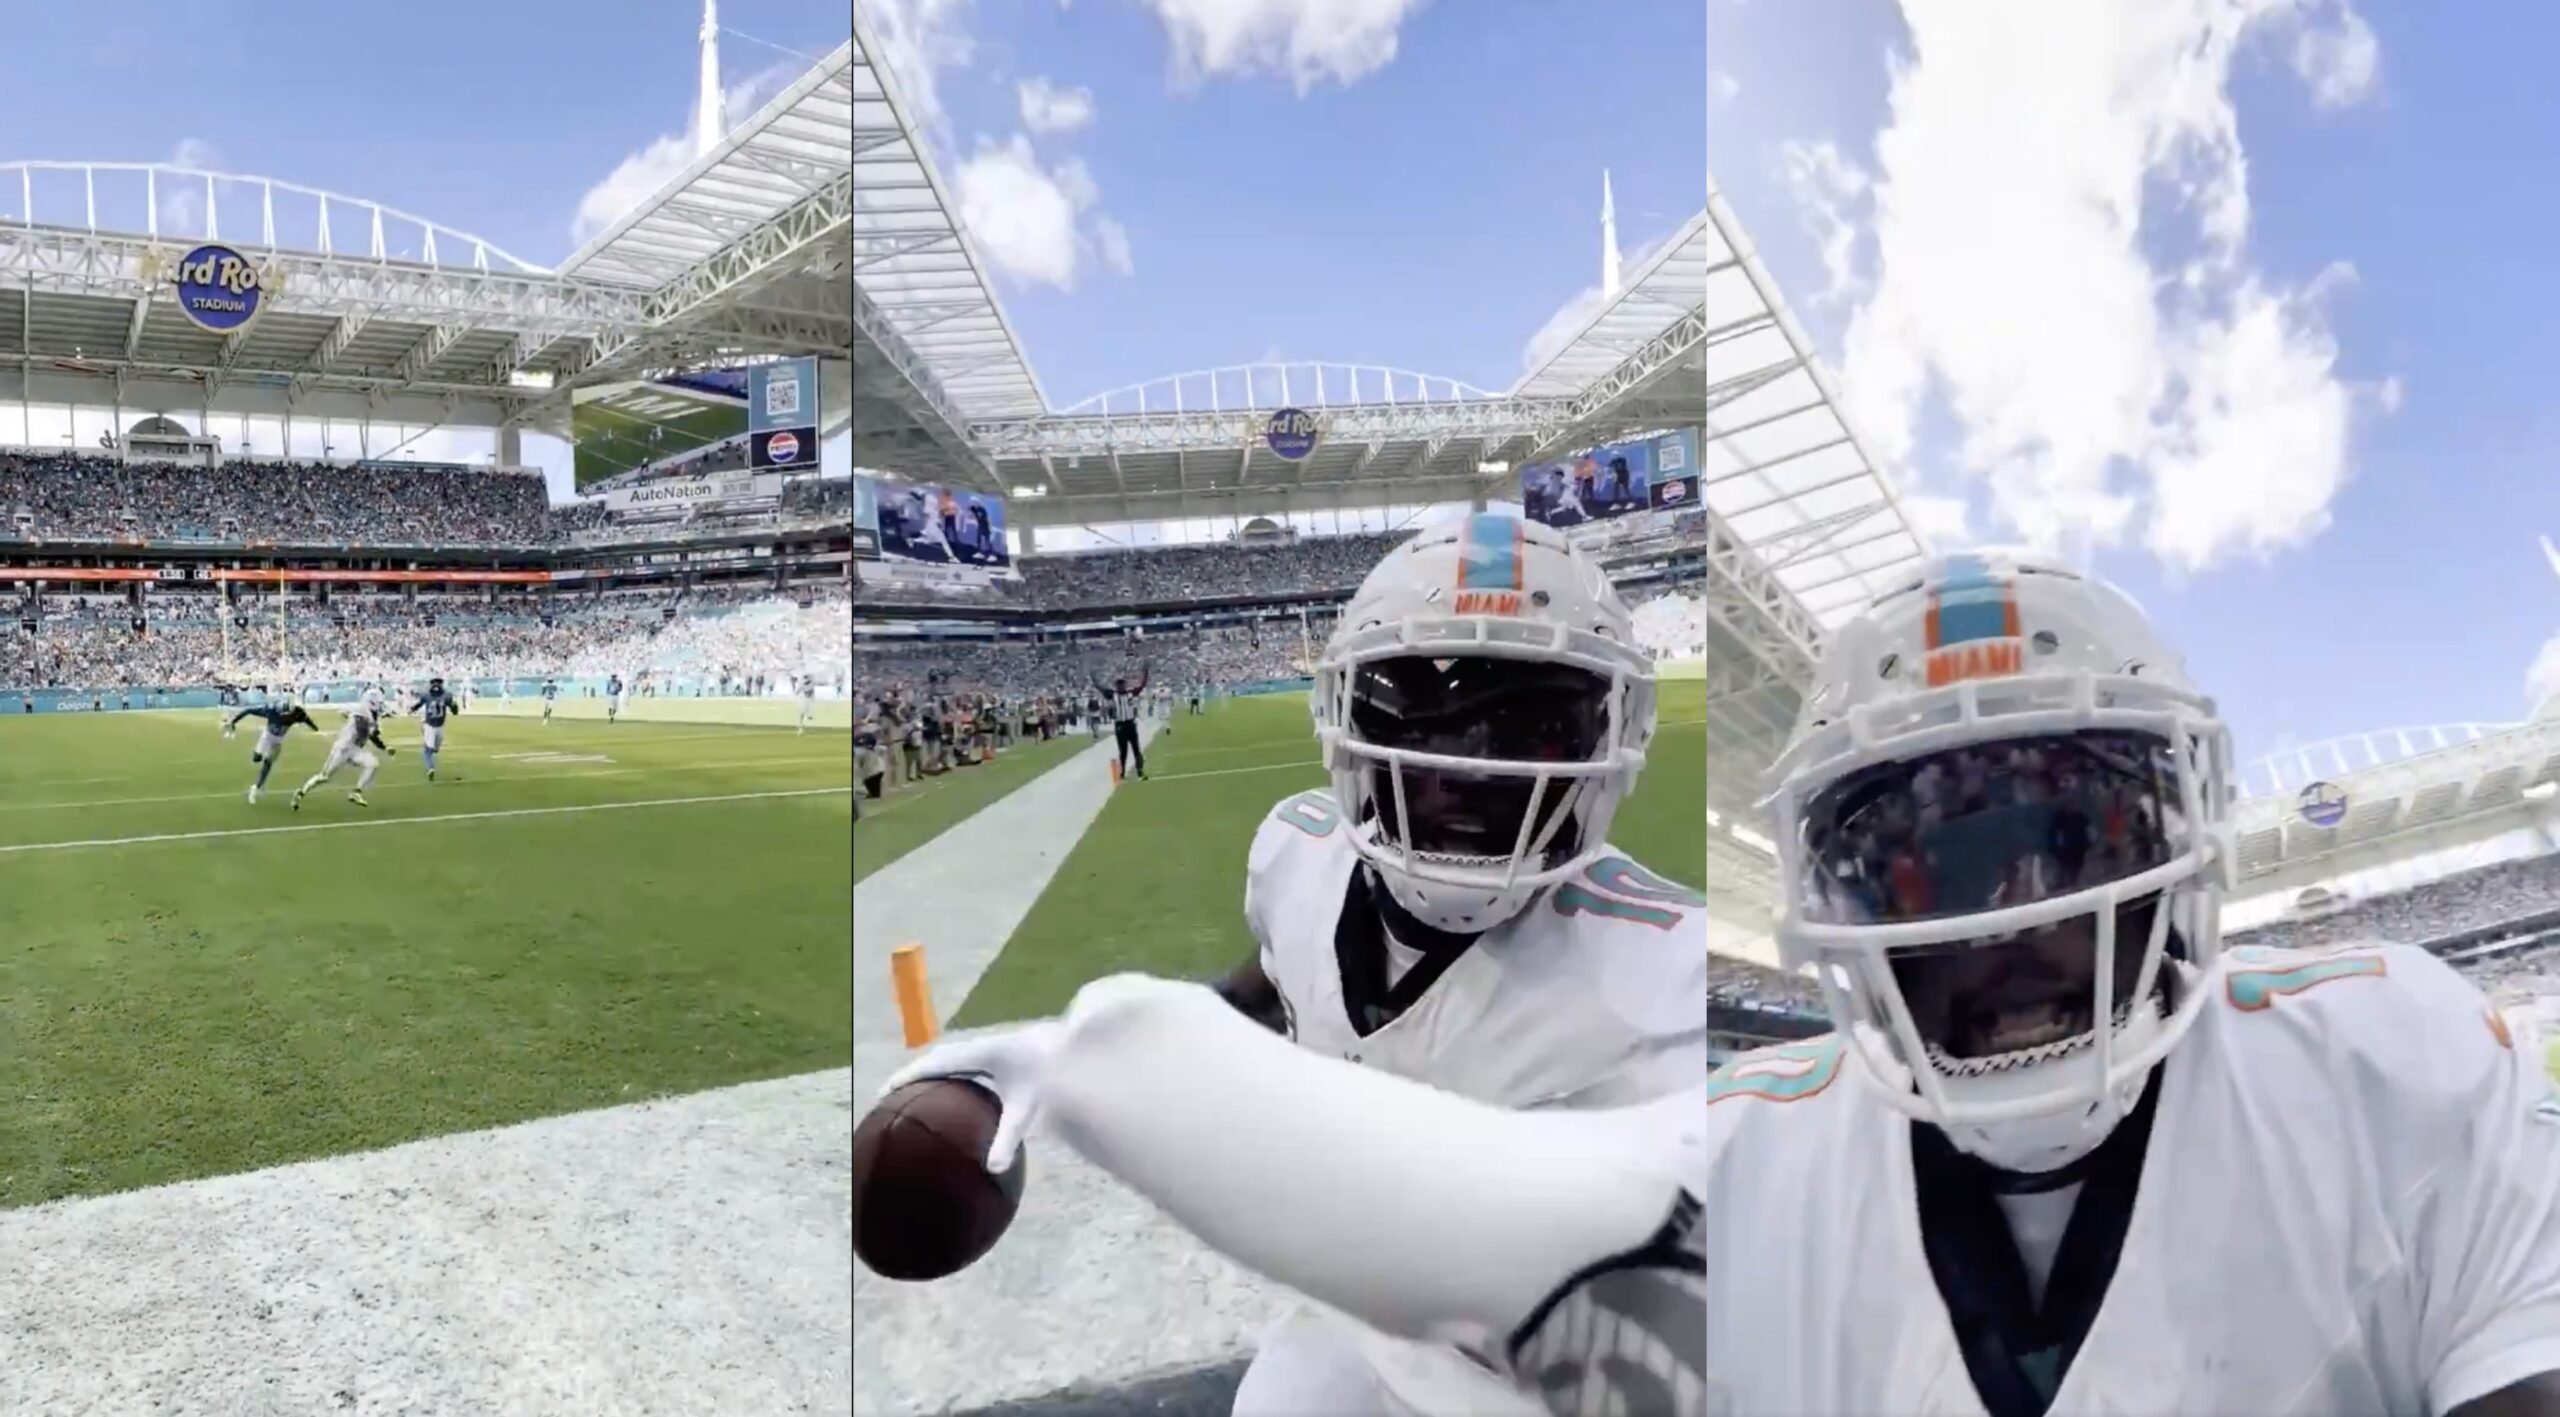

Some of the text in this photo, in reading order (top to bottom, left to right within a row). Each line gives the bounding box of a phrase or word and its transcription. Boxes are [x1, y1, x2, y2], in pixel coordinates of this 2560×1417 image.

[191, 297, 246, 312] STADIUM
[630, 484, 712, 502] AutoNation
[1455, 592, 1520, 616] MIAMI
[1927, 643, 2022, 688] MIAMI
